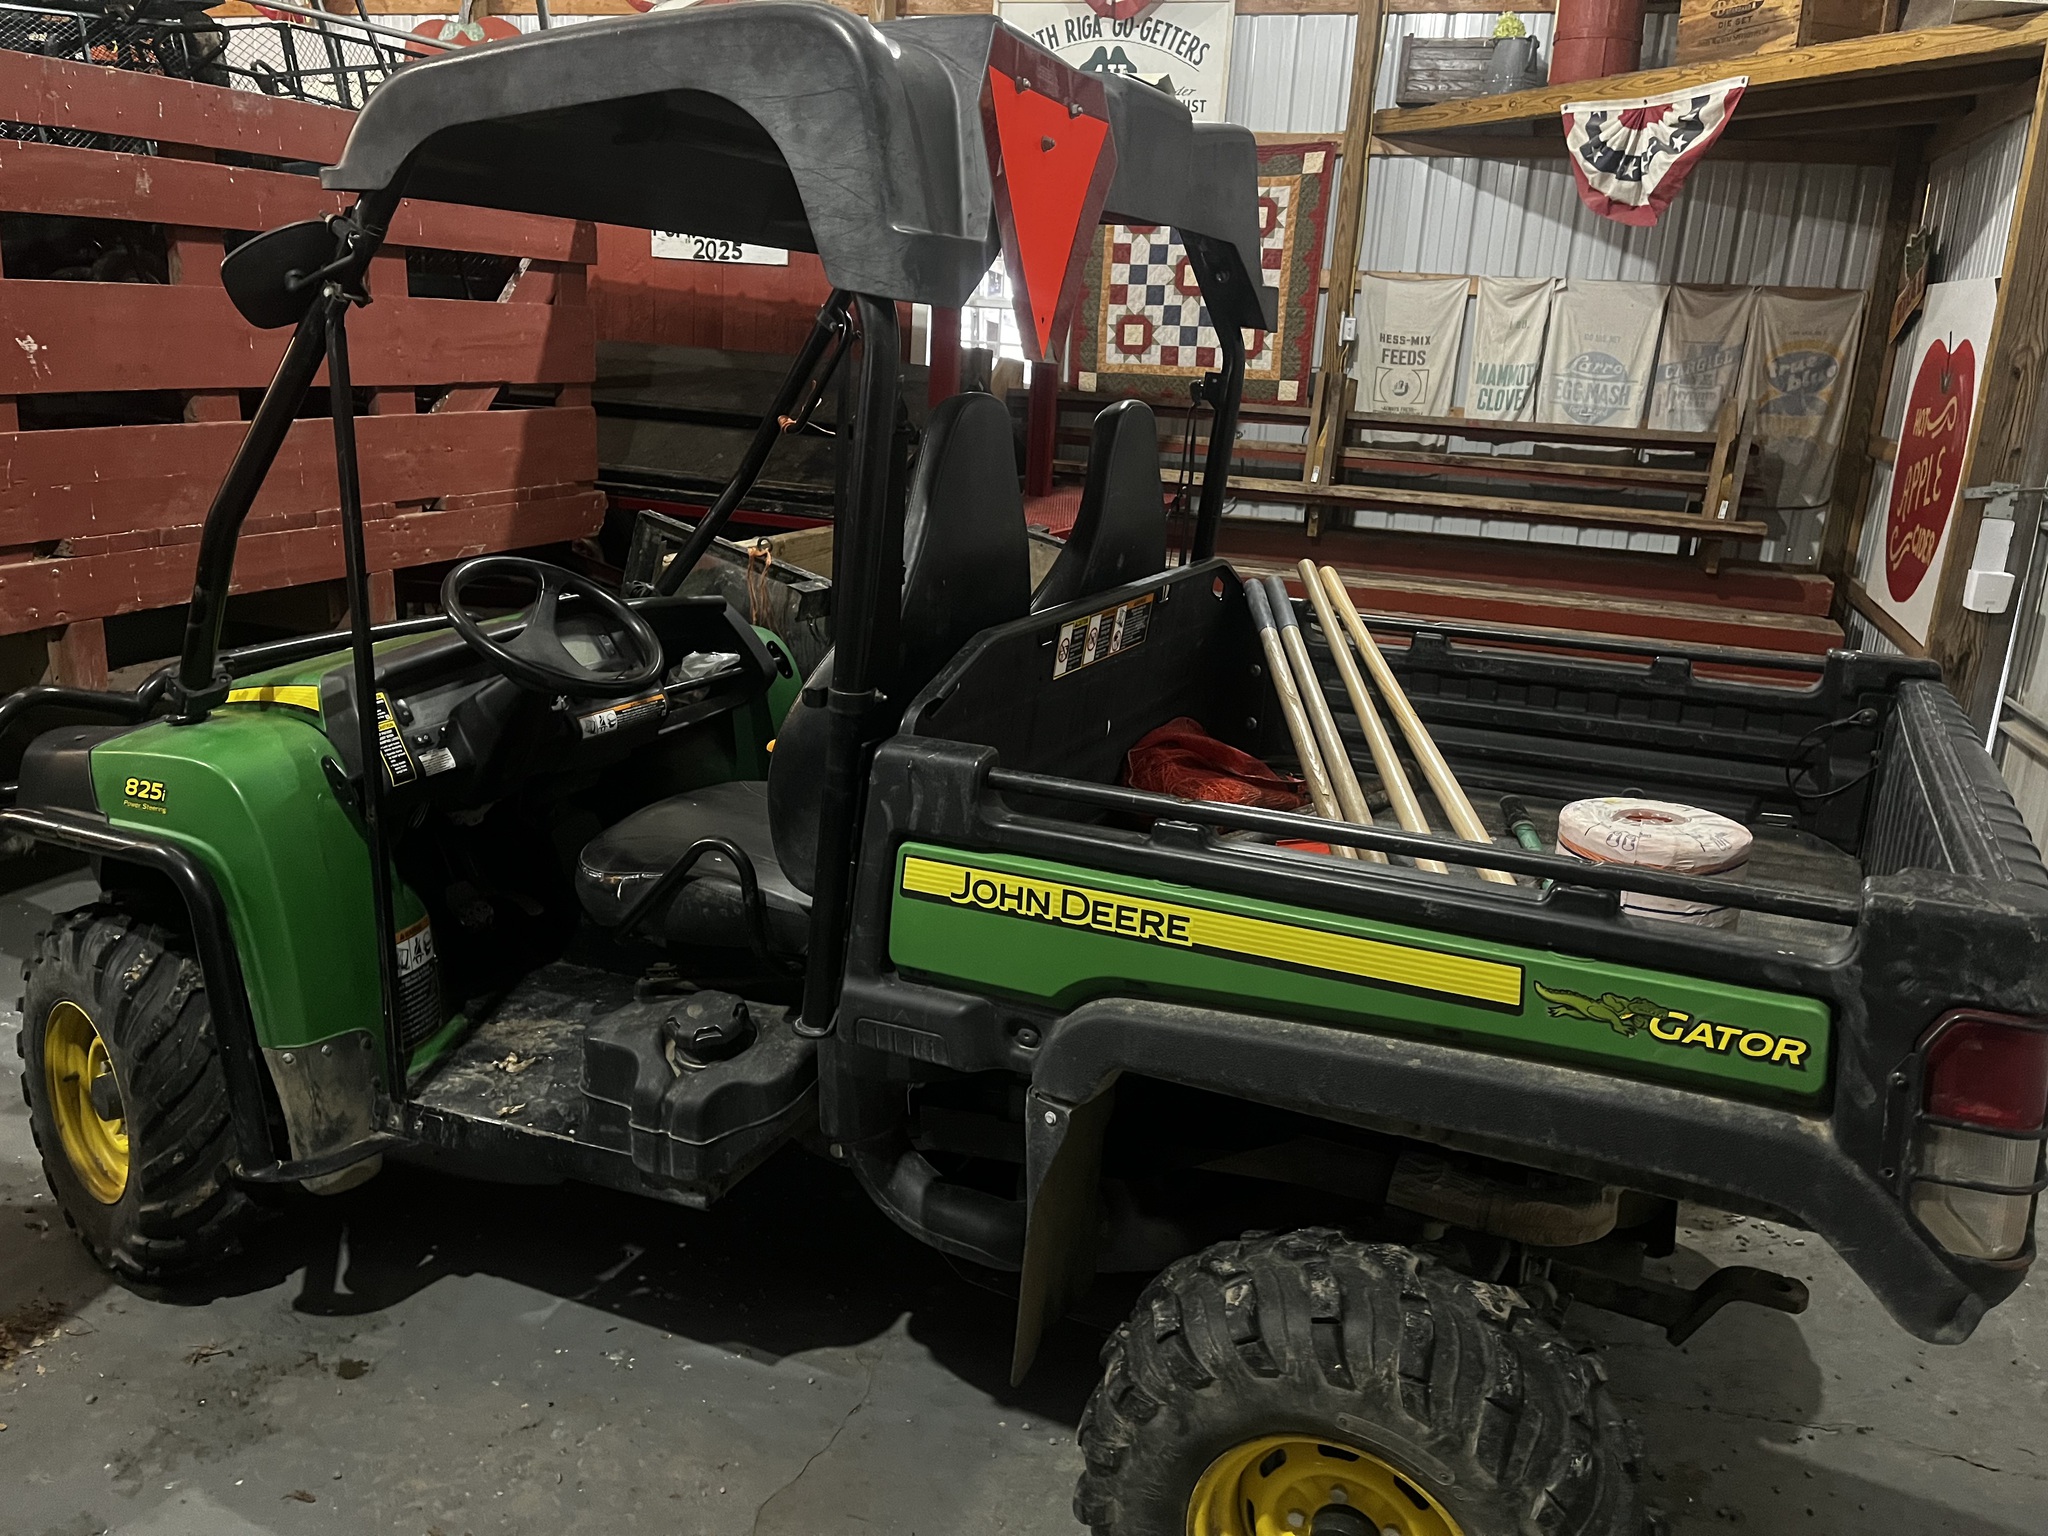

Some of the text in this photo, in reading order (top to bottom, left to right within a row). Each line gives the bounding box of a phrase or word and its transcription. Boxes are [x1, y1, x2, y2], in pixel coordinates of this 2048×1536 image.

[1065, 14, 1102, 43] RIGA
[1718, 15, 1753, 29] DIE SET
[693, 239, 743, 260] 2025
[1380, 333, 1431, 346] HESS-MIX
[1381, 348, 1427, 366] FEEDS
[1665, 351, 1734, 379] CARGILL
[1556, 379, 1631, 406] EGG MASH
[1897, 446, 1946, 522] APPLE
[124, 777, 166, 802] 825i
[950, 871, 1192, 943] JOHN DEERE
[1648, 1010, 1808, 1066] GATOR
